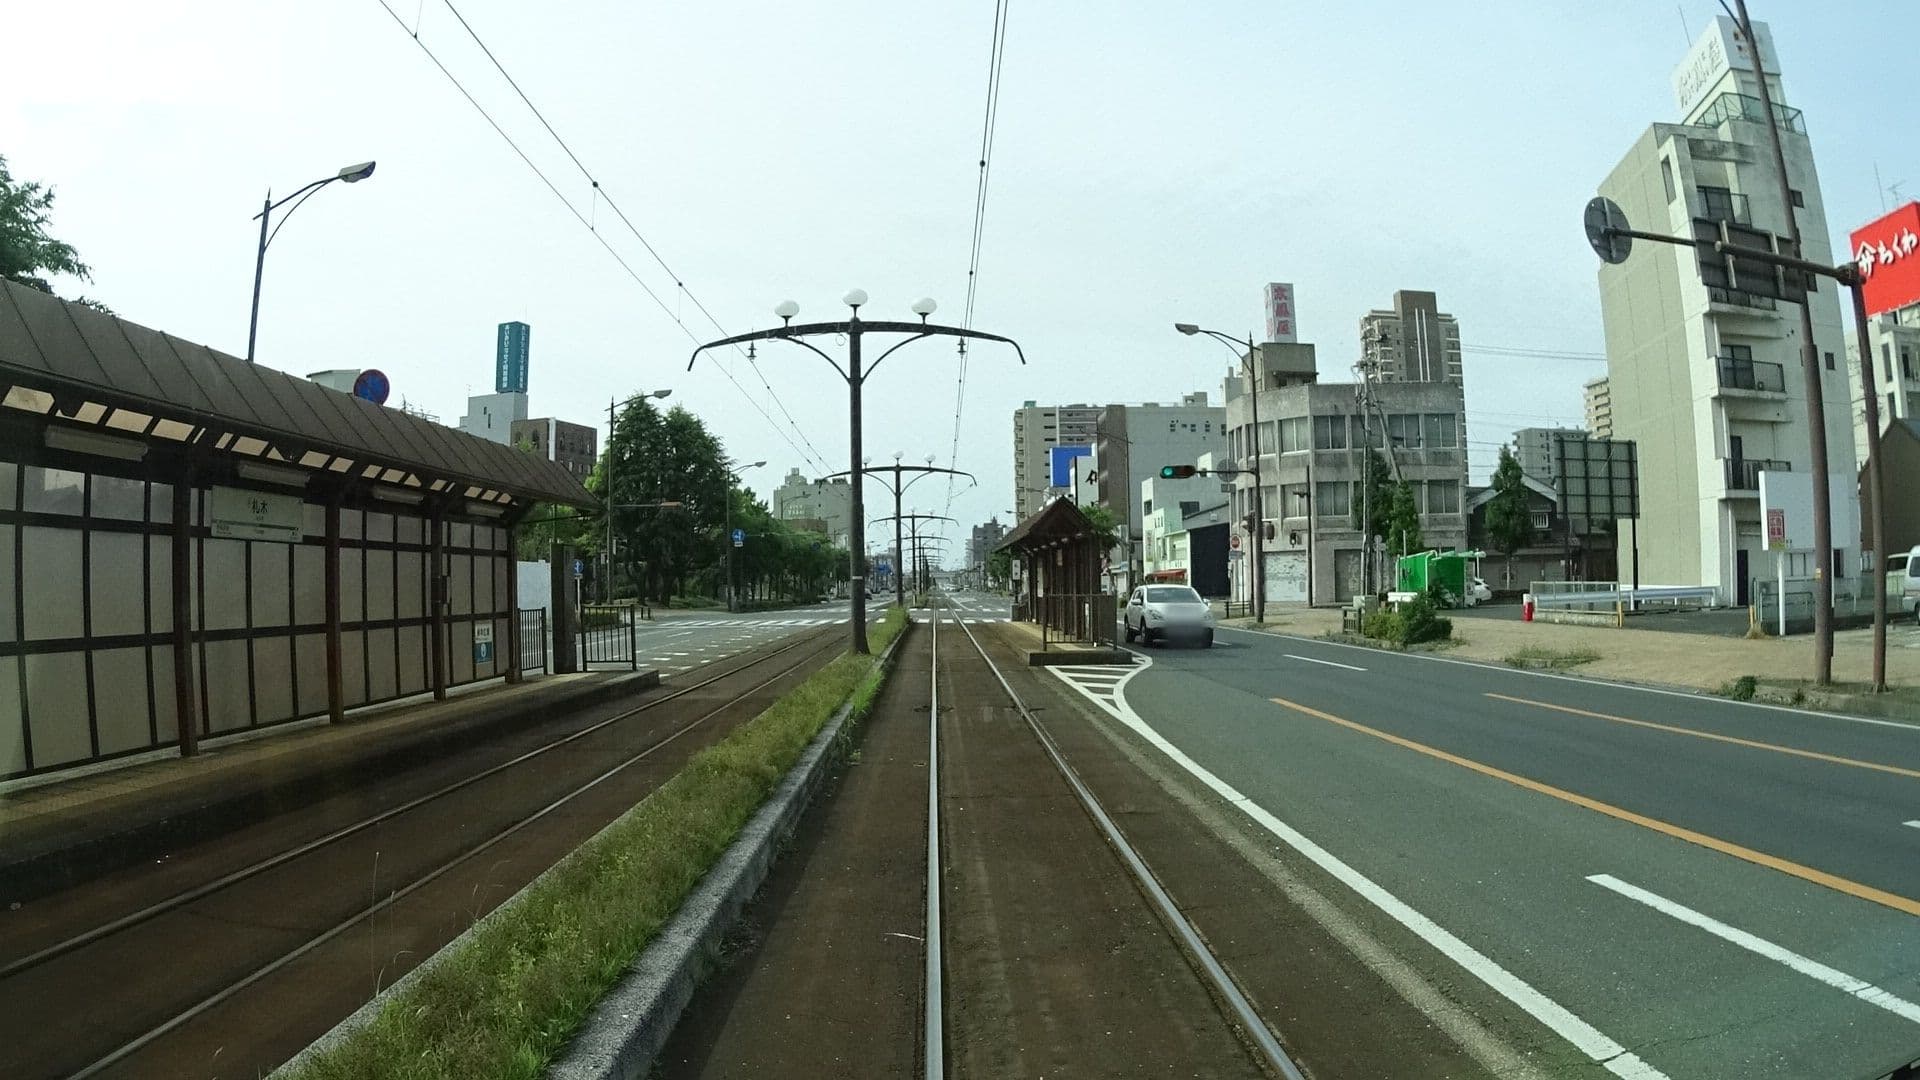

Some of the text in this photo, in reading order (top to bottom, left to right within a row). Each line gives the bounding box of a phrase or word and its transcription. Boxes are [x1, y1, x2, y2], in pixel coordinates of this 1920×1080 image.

[1877, 227, 1919, 265] ちくわ
[251, 498, 268, 514] 札木
